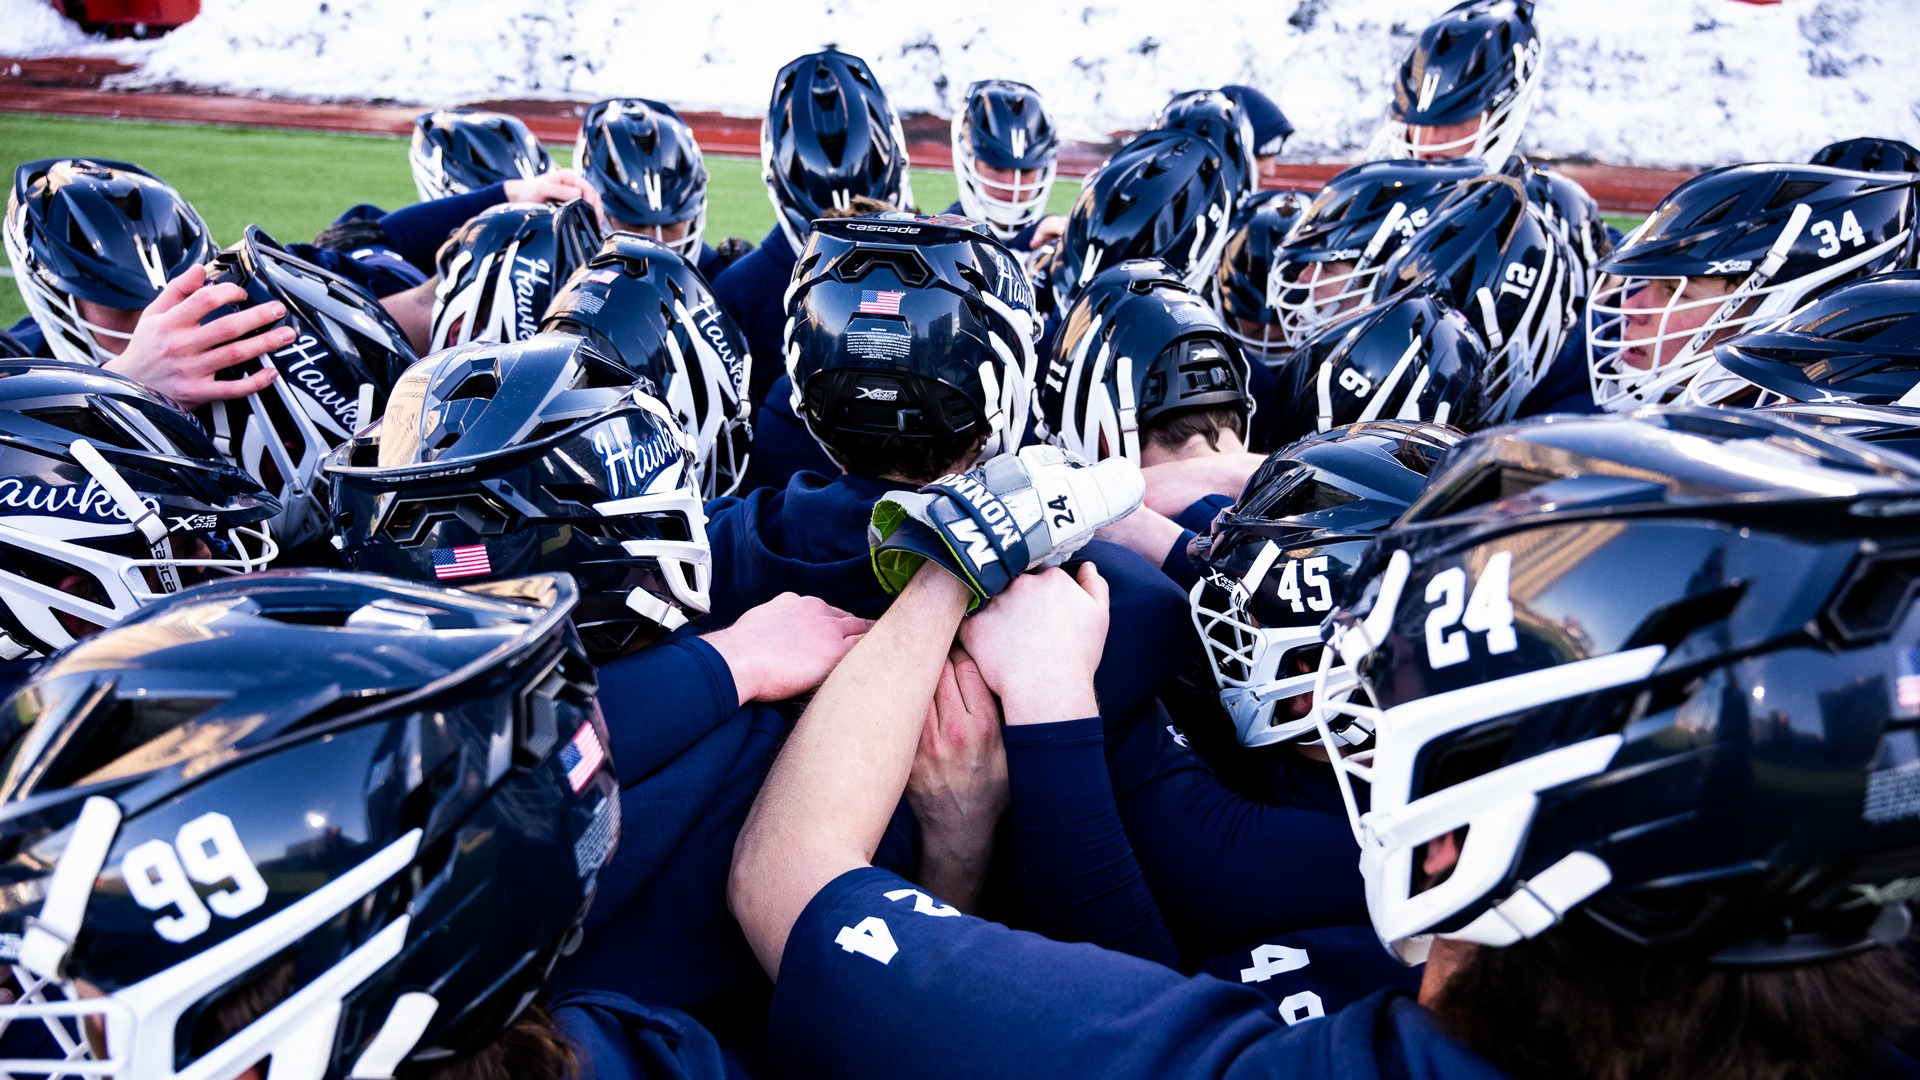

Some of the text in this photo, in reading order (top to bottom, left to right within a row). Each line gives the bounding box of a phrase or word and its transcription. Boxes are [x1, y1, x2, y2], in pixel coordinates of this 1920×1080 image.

[846, 223, 921, 234] cascade
[1811, 210, 1866, 259] 34
[514, 255, 551, 341] Hawk
[1501, 261, 1538, 300] 12
[1045, 359, 1067, 393] 11
[1339, 367, 1371, 398] 9
[371, 466, 476, 482] cascade
[167, 514, 217, 532] XRS
[1047, 494, 1076, 530] 24
[947, 517, 1000, 574] M
[1277, 555, 1333, 613] 45
[1424, 551, 1518, 669] 24
[121, 811, 269, 943] 99
